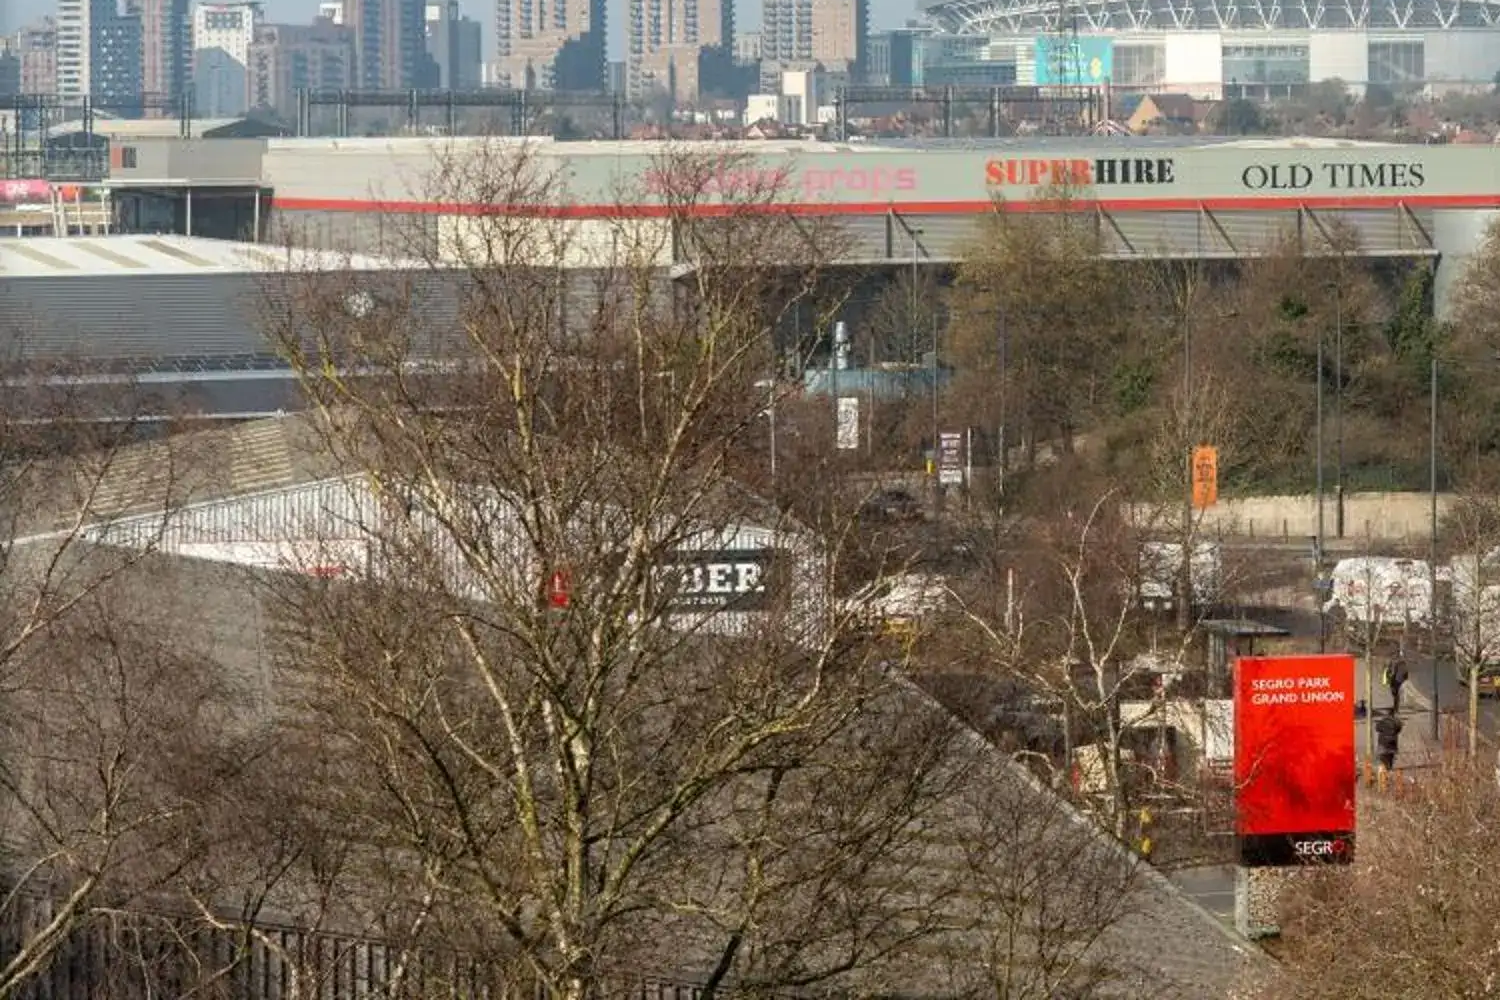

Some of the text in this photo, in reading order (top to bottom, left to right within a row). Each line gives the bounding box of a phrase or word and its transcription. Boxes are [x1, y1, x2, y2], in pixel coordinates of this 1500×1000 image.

[802, 164, 917, 198] props
[985, 157, 1175, 185] SUPERHIRE
[1241, 162, 1425, 189] OLD TIMES
[1252, 676, 1330, 690] SEGRO PARK
[1252, 691, 1345, 705] GRAND UNION
